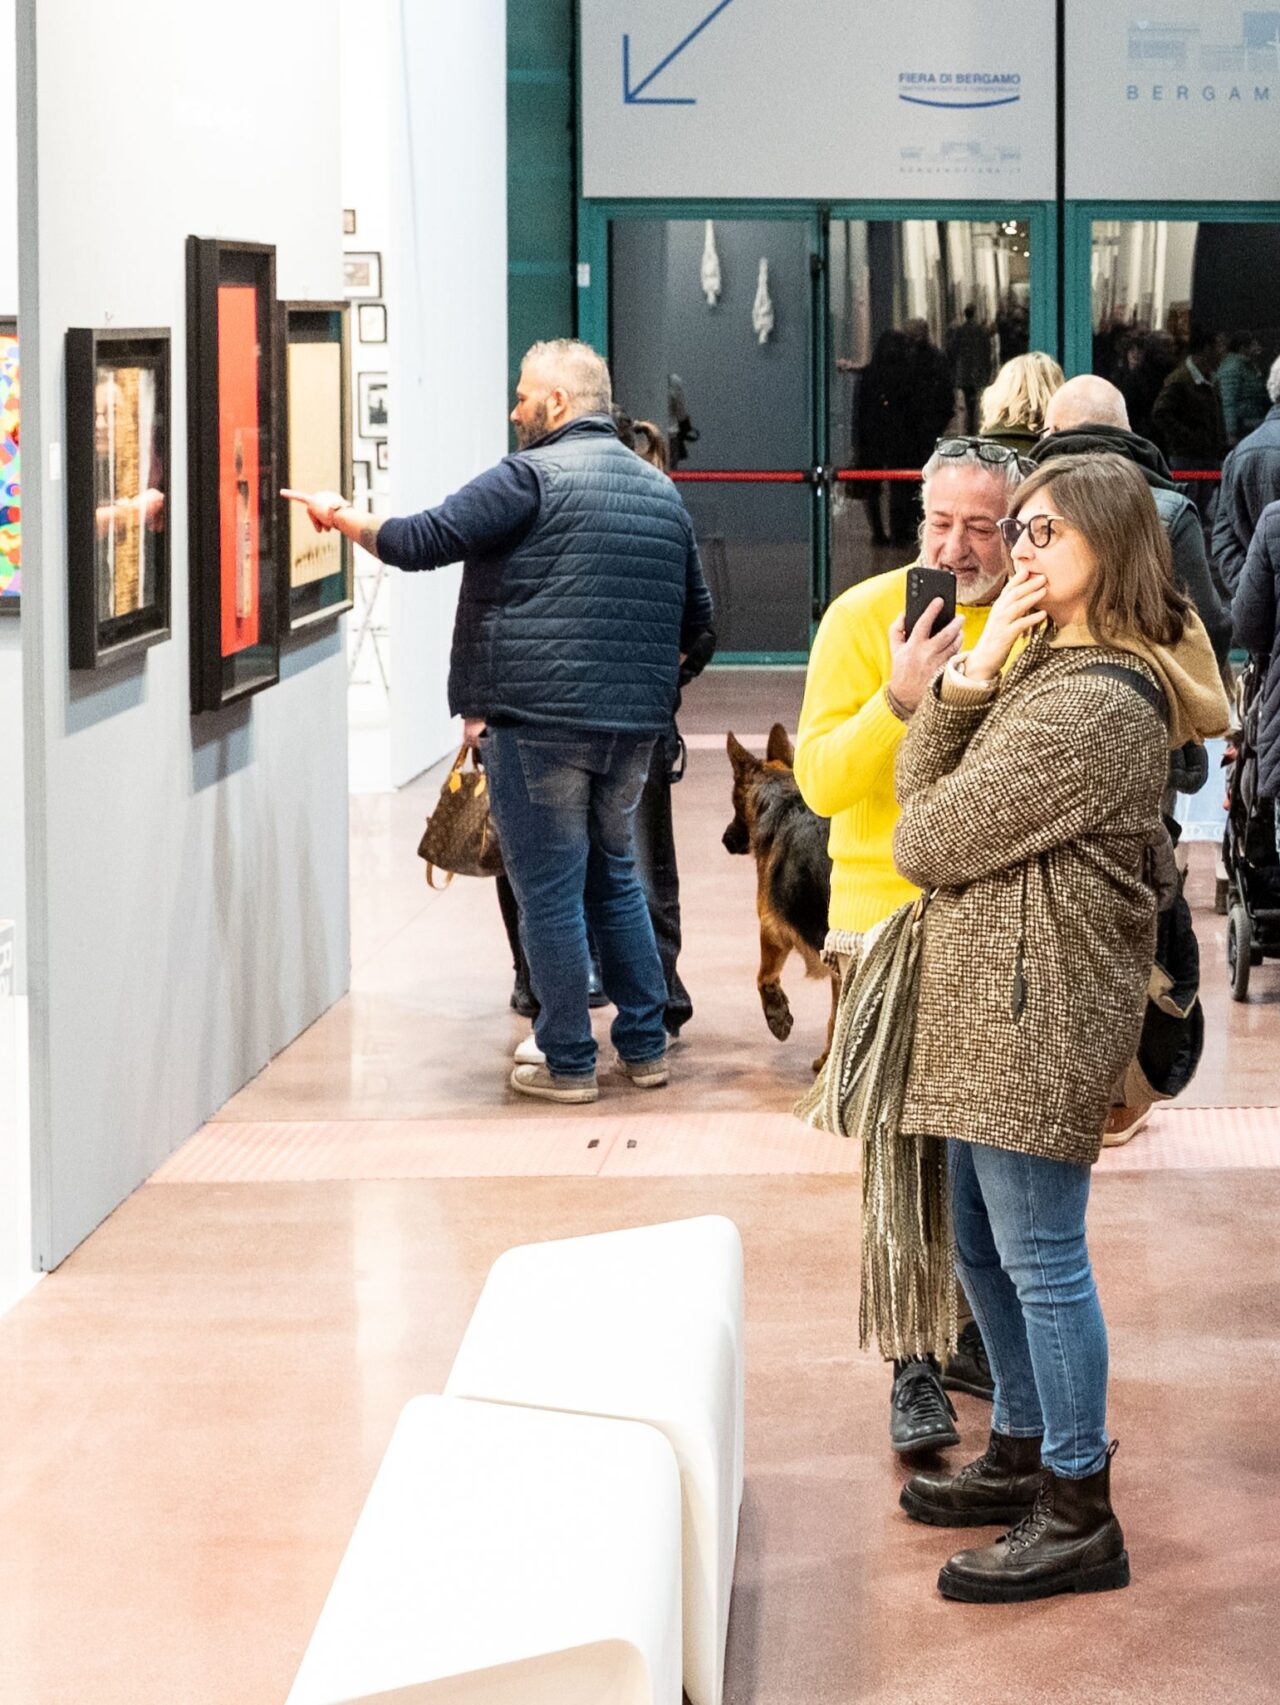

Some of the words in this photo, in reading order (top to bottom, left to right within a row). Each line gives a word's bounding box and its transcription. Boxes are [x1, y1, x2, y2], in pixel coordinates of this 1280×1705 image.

[899, 73, 935, 84] FIERA
[940, 73, 953, 84] DI
[956, 73, 1021, 85] BERGAMO
